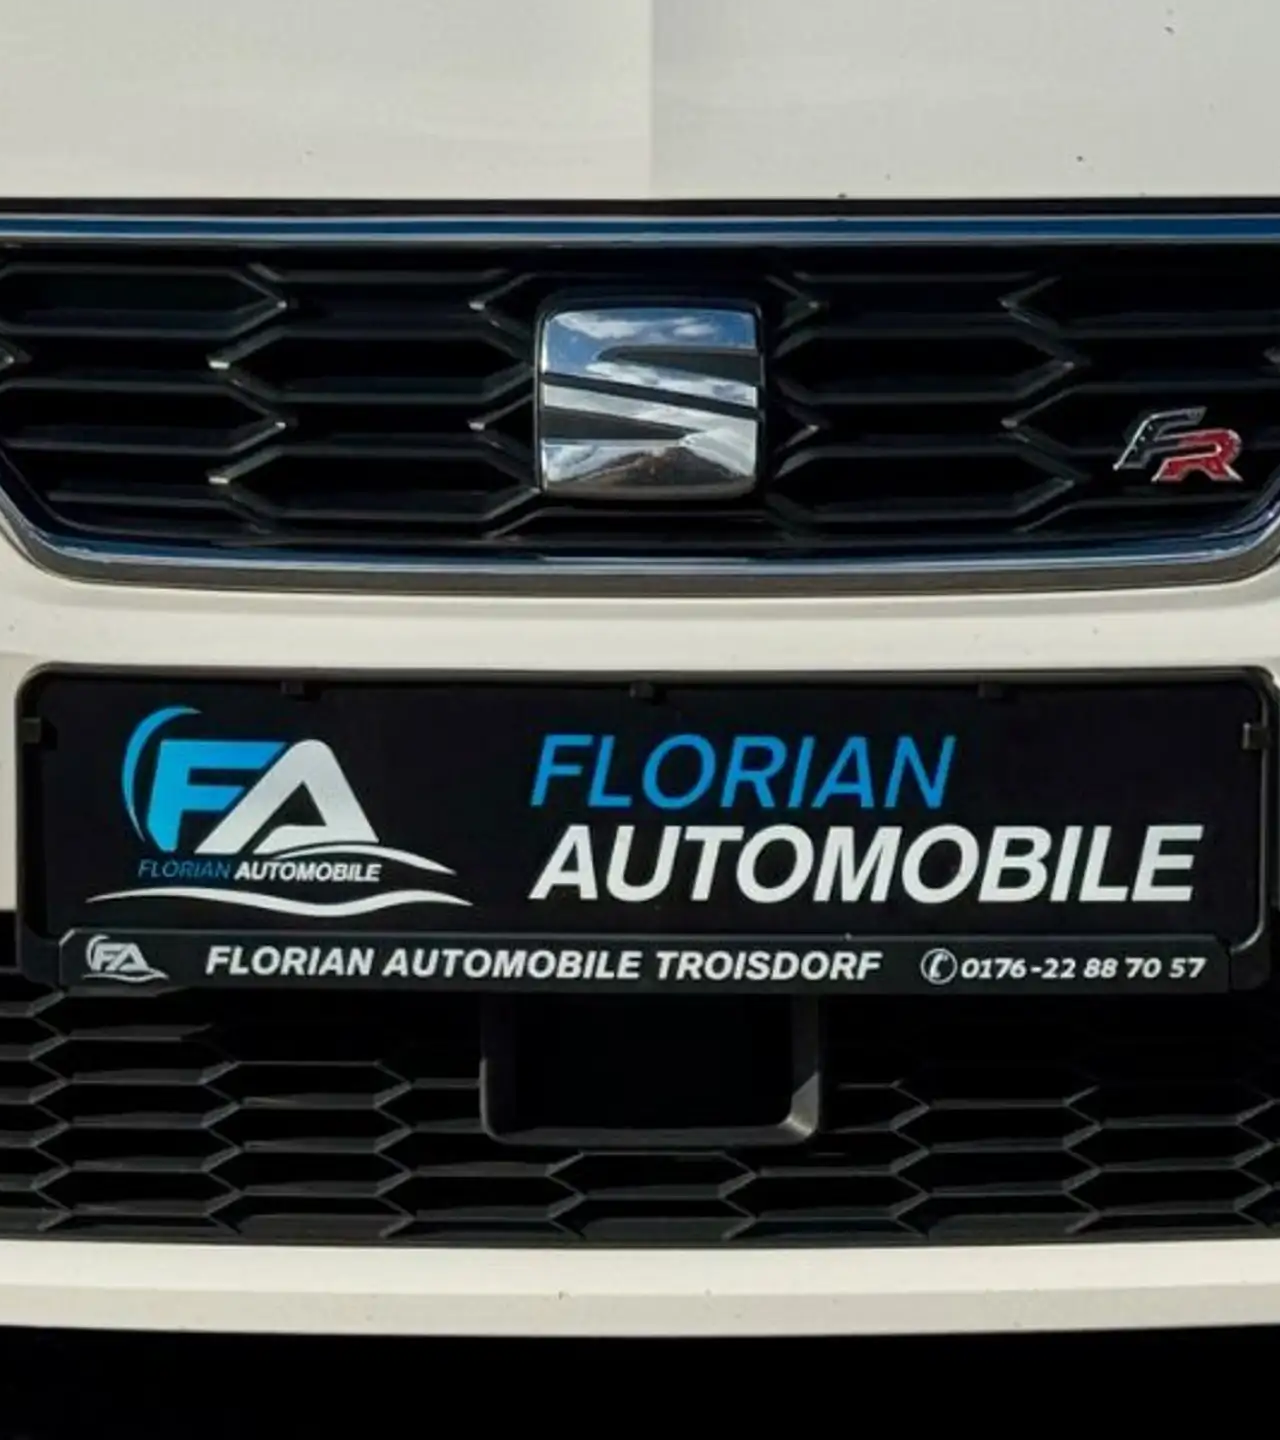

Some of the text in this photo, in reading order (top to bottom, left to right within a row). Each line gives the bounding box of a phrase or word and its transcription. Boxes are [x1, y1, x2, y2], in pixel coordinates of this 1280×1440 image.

[1113, 406, 1243, 482] FR
[146, 739, 380, 855] FA
[529, 733, 957, 810] FLORIAN
[137, 858, 382, 884] FLORIAN AUTOMOBILE
[528, 824, 1204, 904] AUTOMOBILE
[204, 945, 883, 982] FLORIAN AUTOMOBILE TROISDORF
[960, 956, 1207, 980] 0176-22 88 70 57
